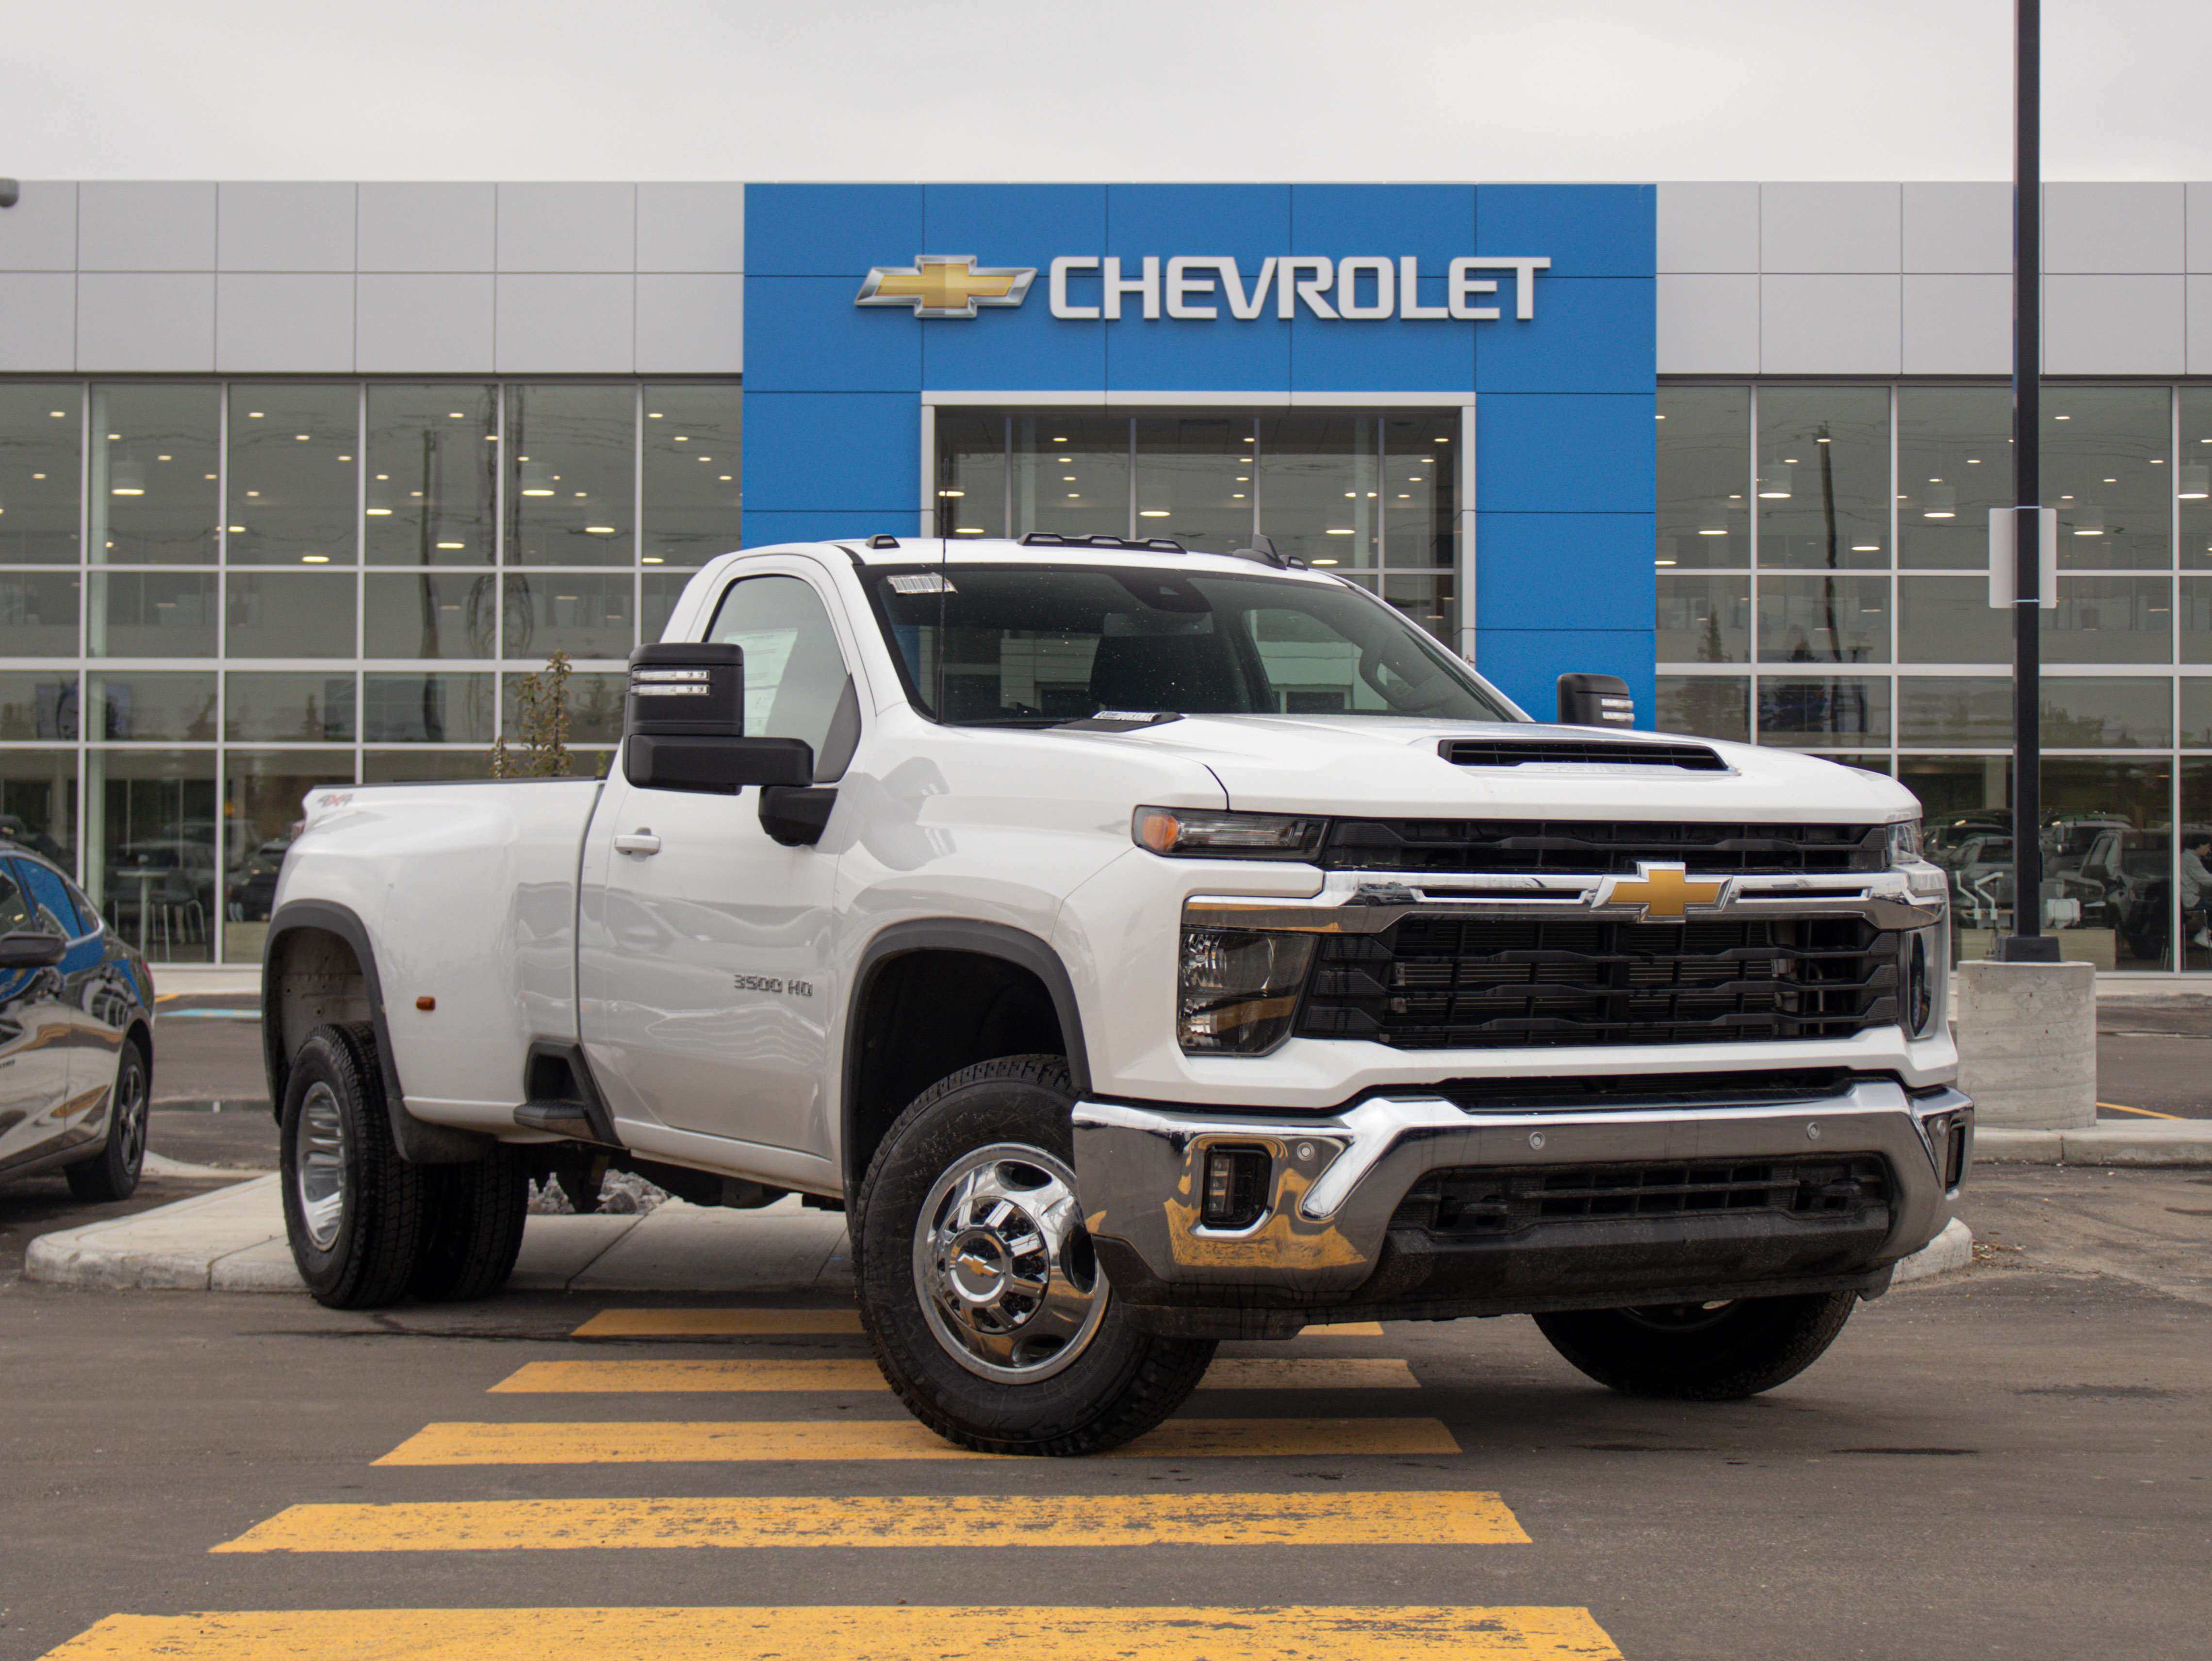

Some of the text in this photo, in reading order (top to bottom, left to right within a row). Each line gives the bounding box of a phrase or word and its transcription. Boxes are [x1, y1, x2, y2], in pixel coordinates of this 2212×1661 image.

[1050, 256, 1551, 320] CHEVROLET
[734, 974, 813, 996] 3500 HD
